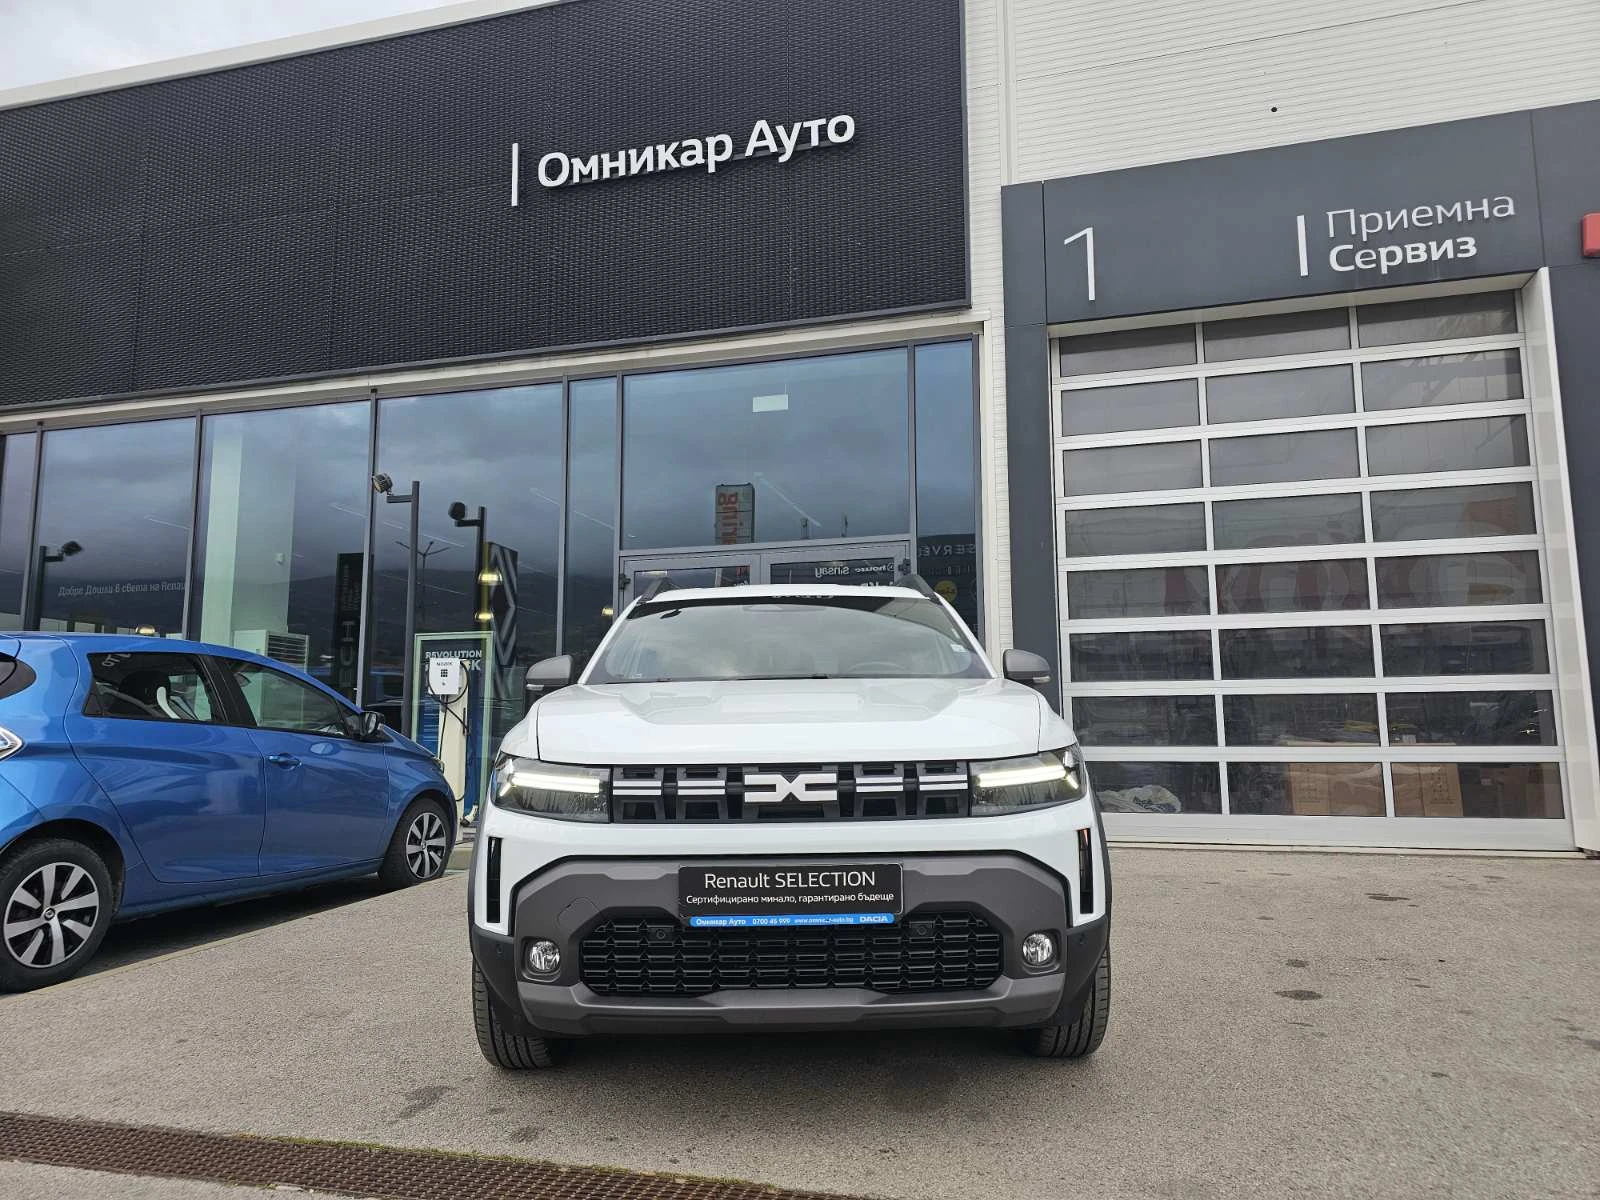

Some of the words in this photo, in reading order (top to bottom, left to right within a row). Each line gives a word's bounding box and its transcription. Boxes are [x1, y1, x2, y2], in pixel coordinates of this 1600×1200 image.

[537, 133, 734, 189] Омникар
[744, 113, 856, 164] Ауто
[1325, 193, 1516, 240] Приемна
[1062, 226, 1097, 302] 1
[1328, 234, 1479, 275] Сервиз
[425, 650, 482, 659] REVOLUTION
[704, 872, 771, 889] Renault
[774, 871, 876, 889] SELECTION
[686, 894, 759, 906] Сертифицирано
[798, 893, 856, 904] гарантирано
[857, 891, 895, 903] бъдеще
[695, 918, 728, 927] Омникар
[728, 917, 747, 927] Ауто
[859, 915, 889, 924] DACIA
